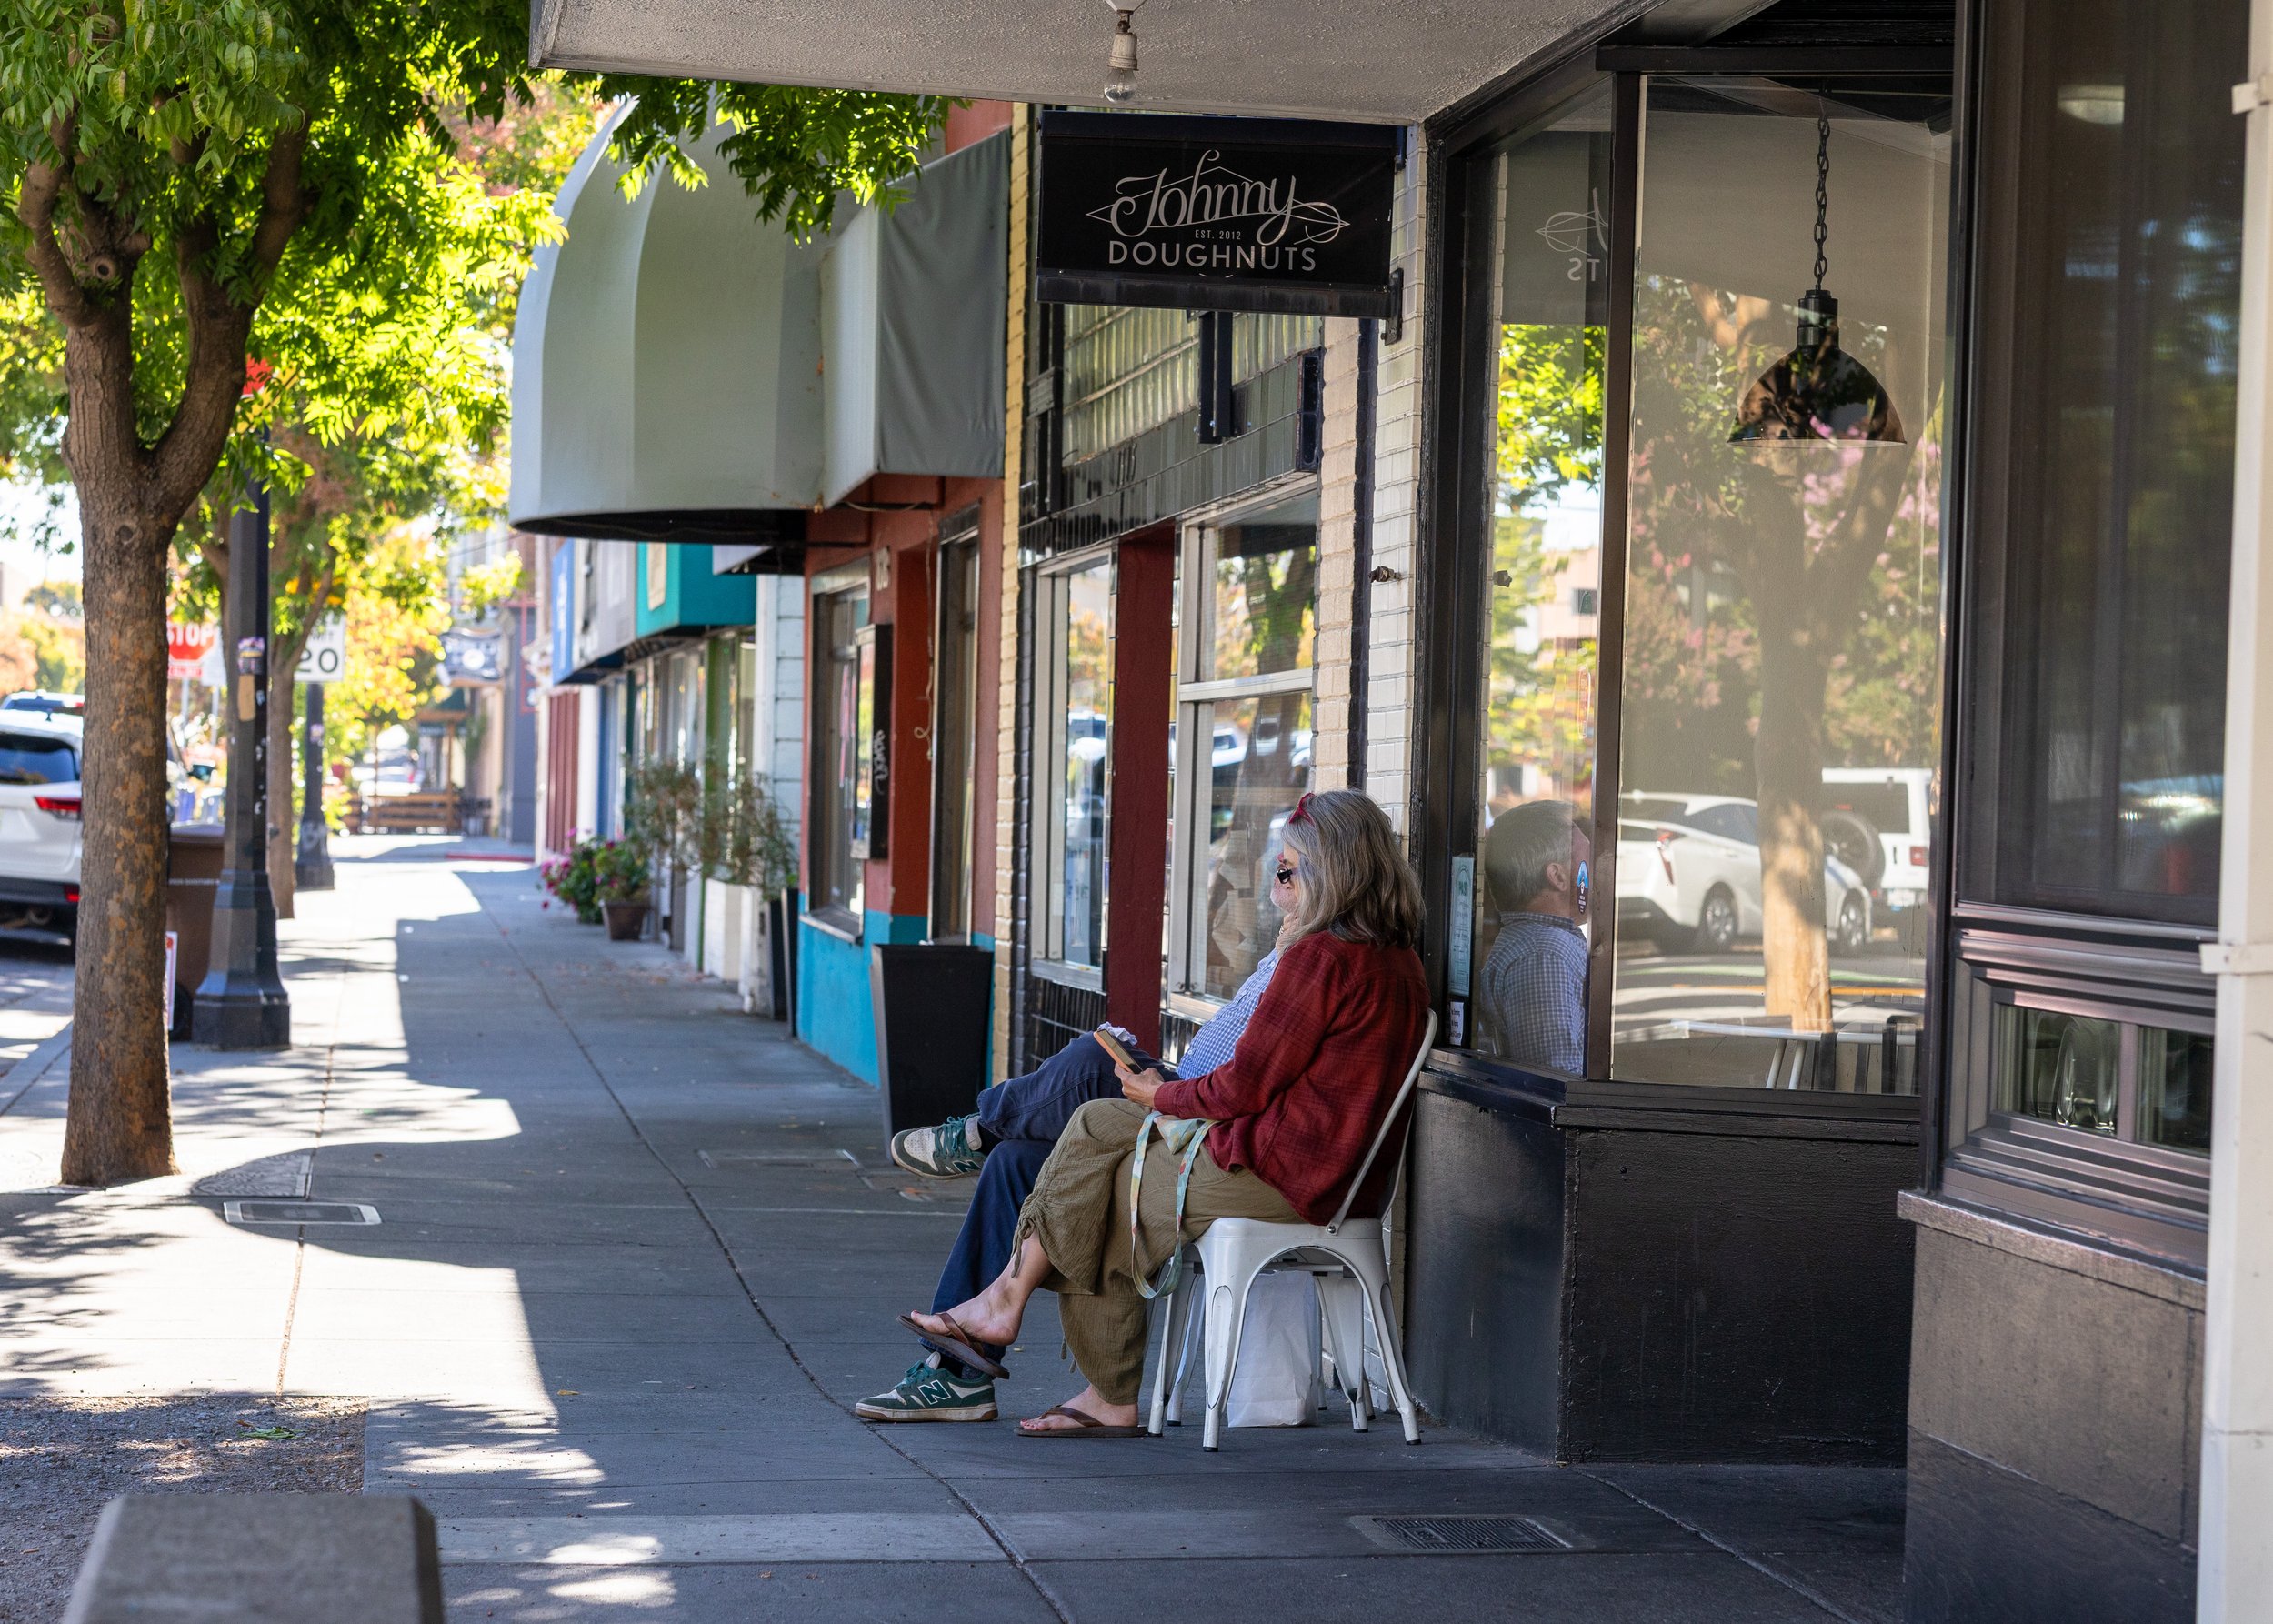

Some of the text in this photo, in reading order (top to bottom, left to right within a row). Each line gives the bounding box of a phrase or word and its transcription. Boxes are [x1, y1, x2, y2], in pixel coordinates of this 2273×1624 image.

[1110, 149, 1297, 246] Johnny
[1195, 229, 1241, 240] EST. 2012
[1108, 240, 1317, 271] DOUGHNUTS
[296, 648, 339, 673] 20
[917, 1379, 952, 1405] N
